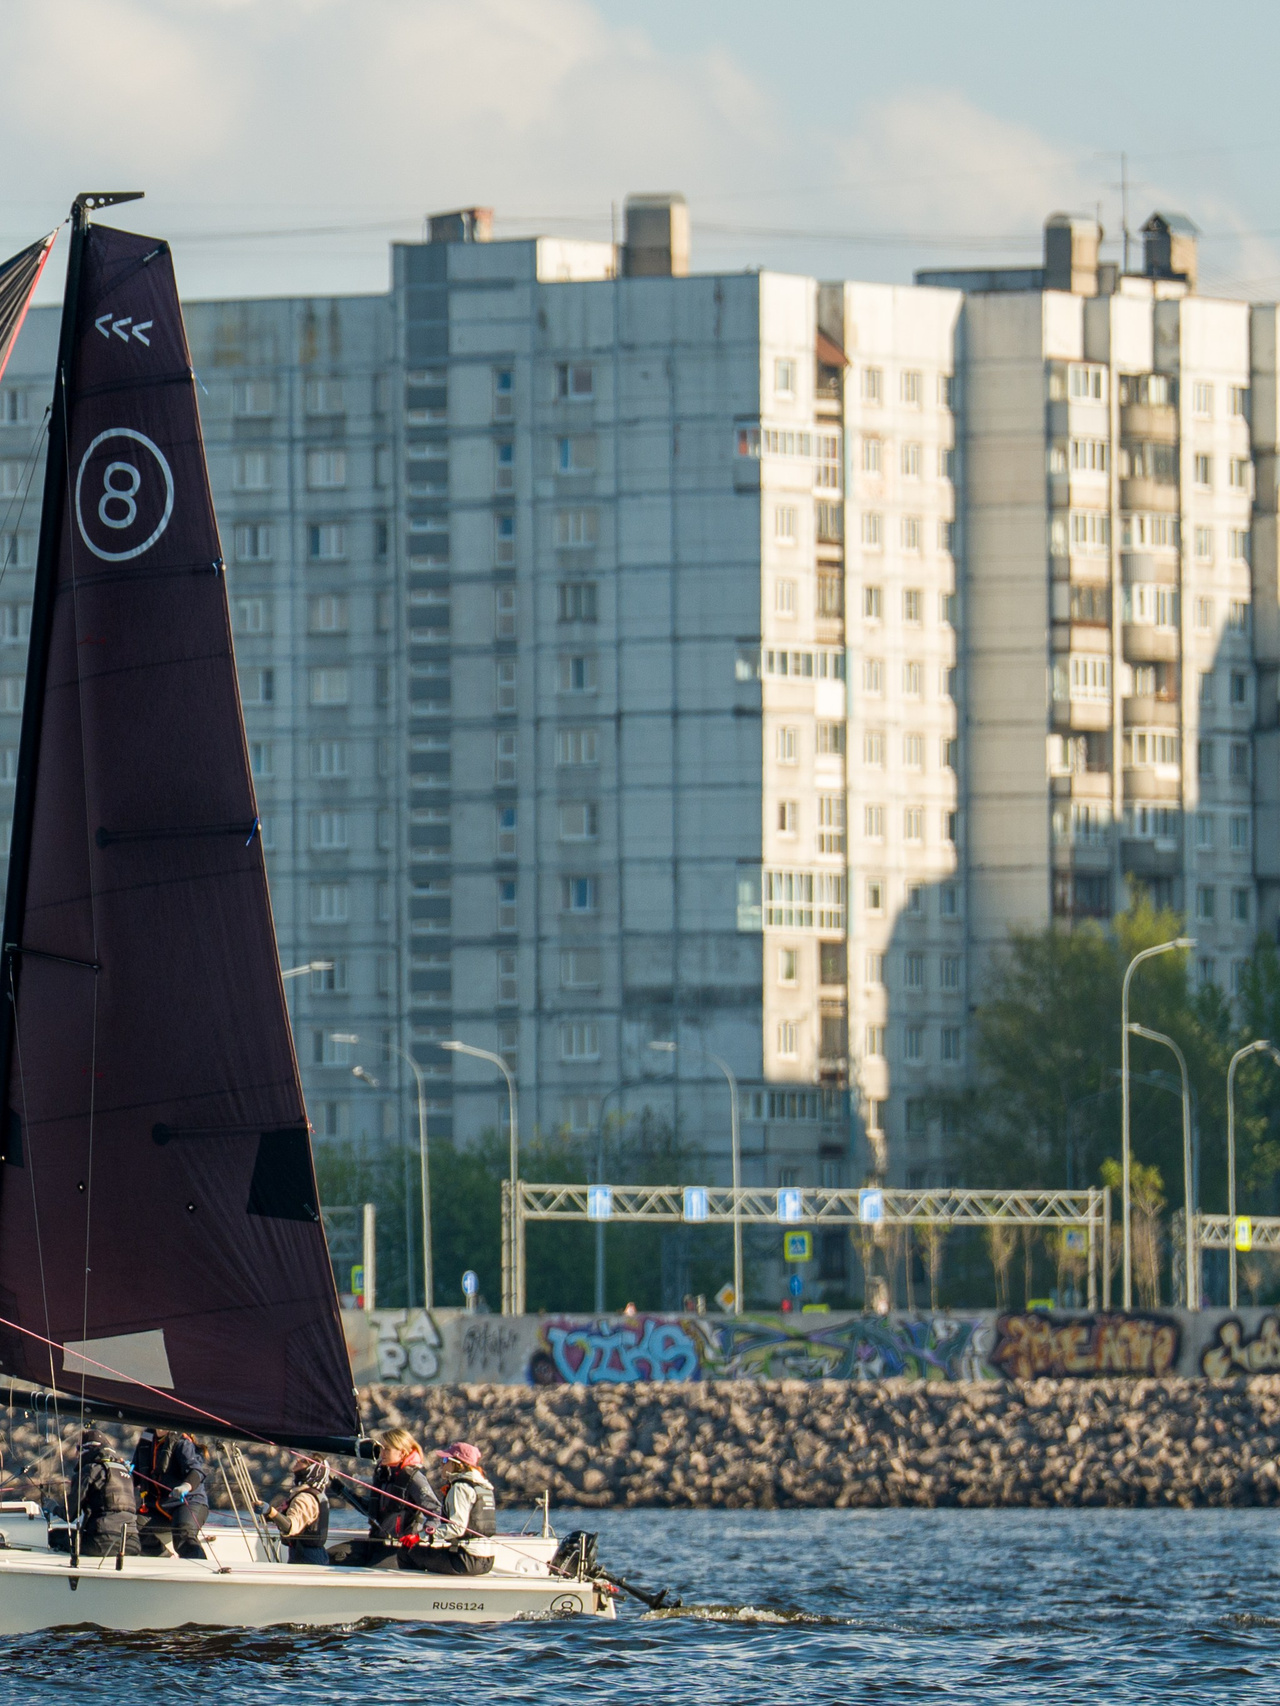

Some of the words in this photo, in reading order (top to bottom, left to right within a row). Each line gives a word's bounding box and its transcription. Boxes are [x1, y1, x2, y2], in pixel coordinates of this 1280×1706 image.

[98, 461, 141, 529] 8
[432, 1601, 485, 1611] RUS6124
[561, 1601, 574, 1613] 8
